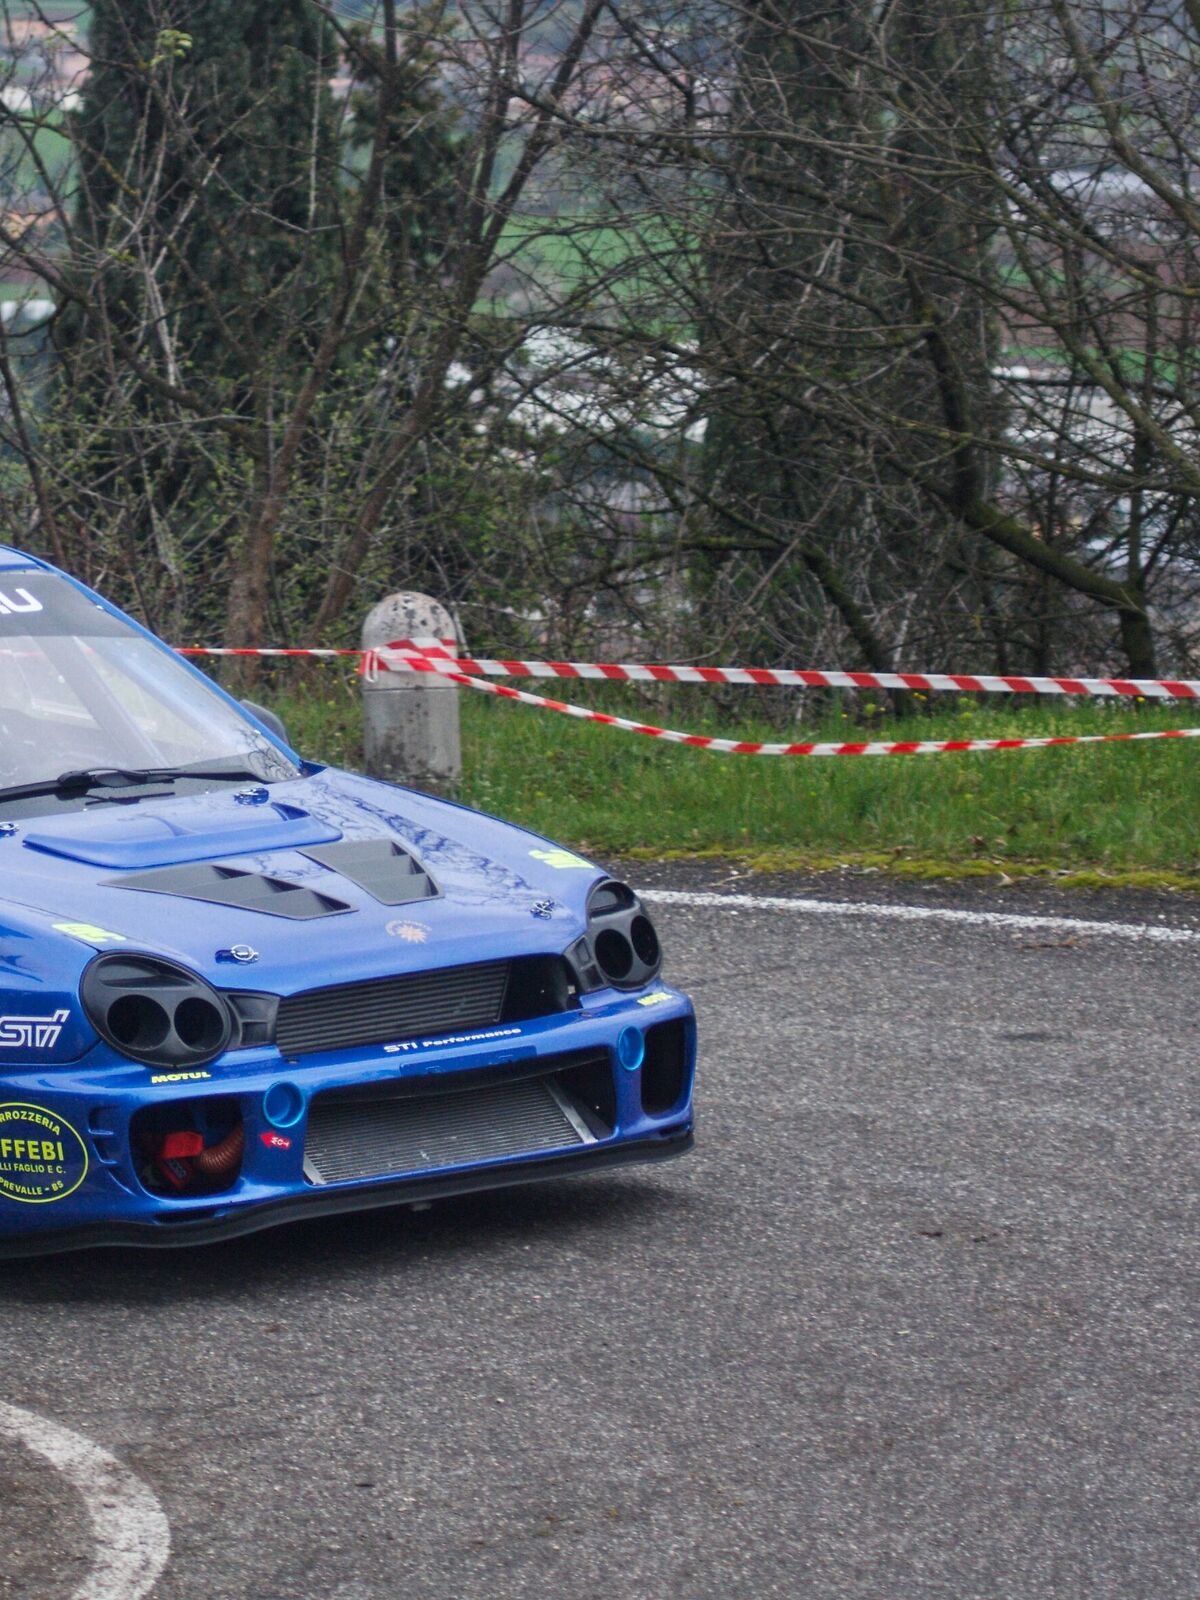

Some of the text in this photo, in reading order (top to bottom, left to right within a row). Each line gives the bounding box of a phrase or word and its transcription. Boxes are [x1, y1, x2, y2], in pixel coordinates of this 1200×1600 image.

[422, 1028, 522, 1048] Performance
[151, 1071, 212, 1084] MOTUL
[13, 1163, 45, 1173] FAGLIO
[47, 1165, 54, 1174] E
[55, 1165, 67, 1174] C.
[51, 1180, 64, 1192] BS
